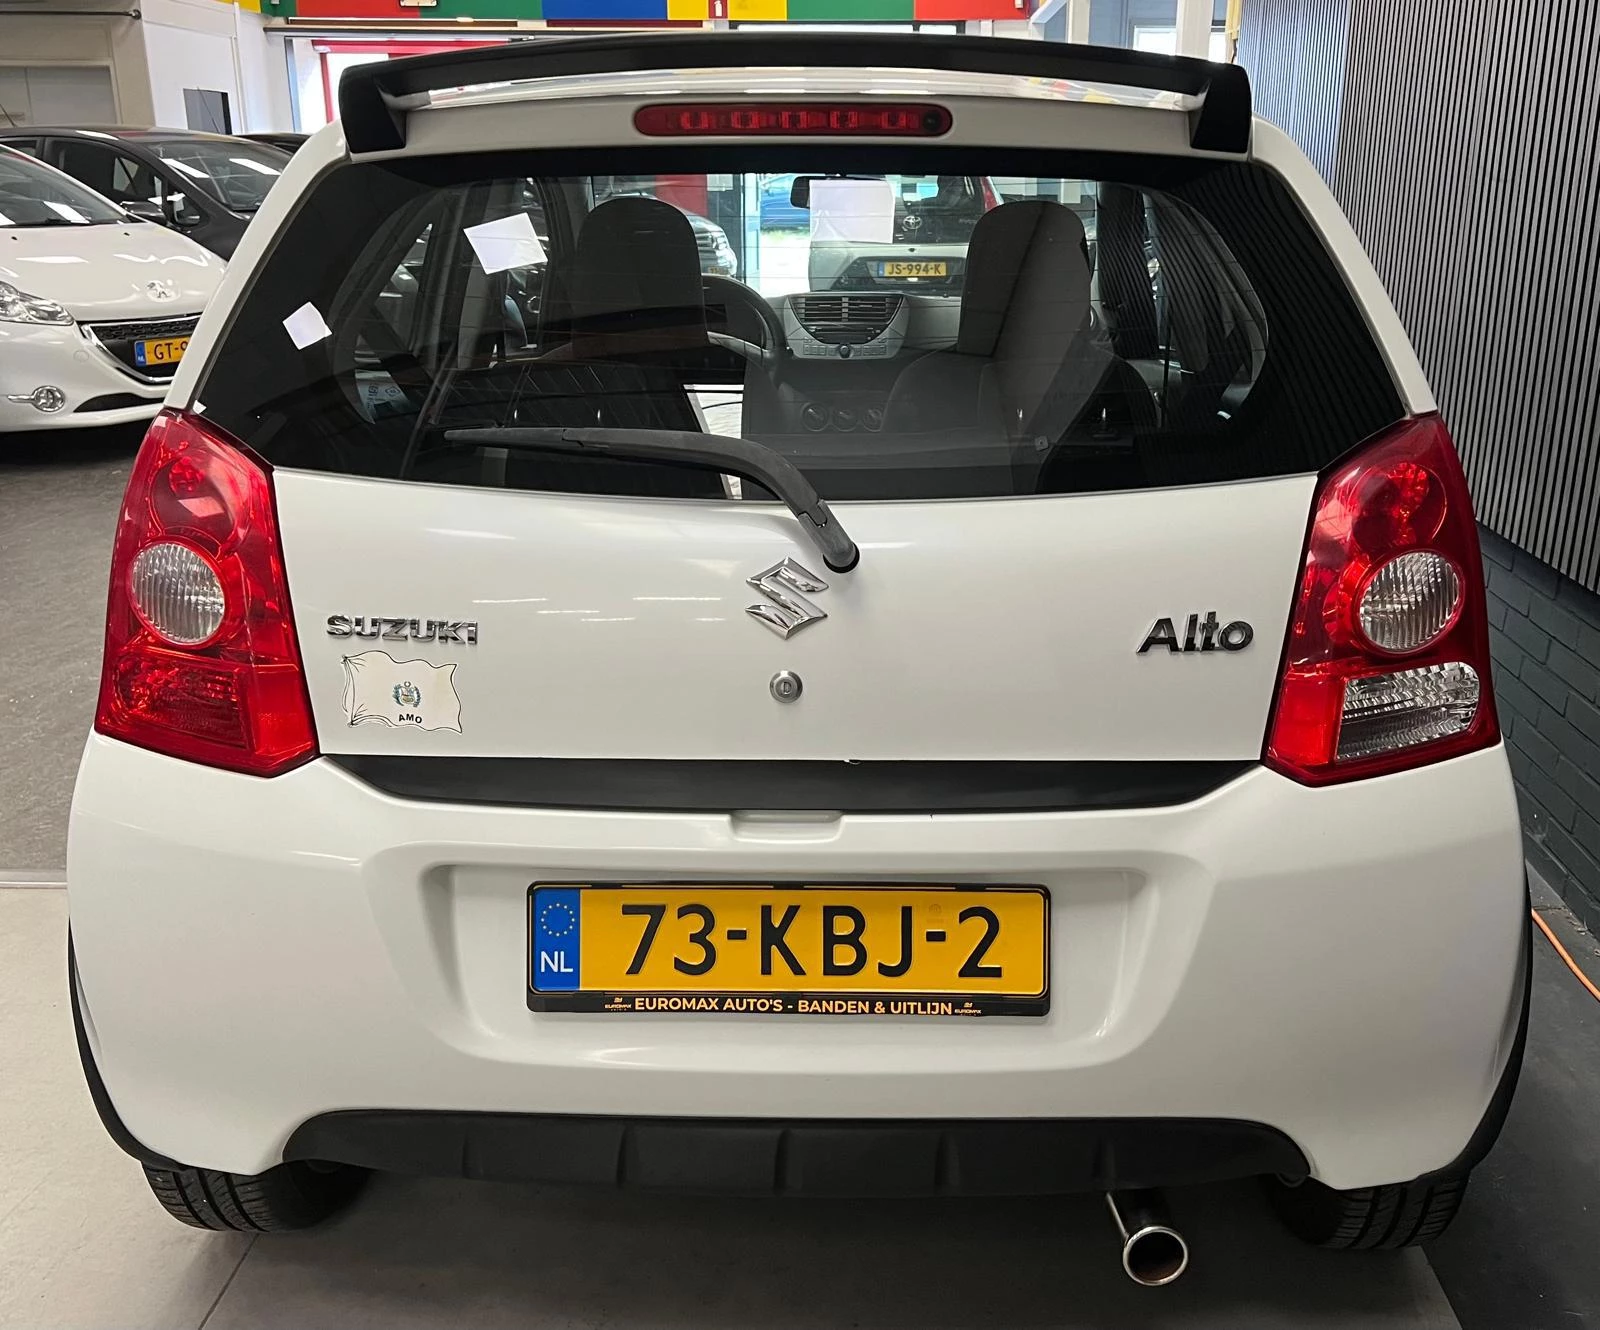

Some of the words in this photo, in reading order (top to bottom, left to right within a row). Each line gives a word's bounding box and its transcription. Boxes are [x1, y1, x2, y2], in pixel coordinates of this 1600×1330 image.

[888, 263, 942, 275] JS-994-K
[326, 614, 479, 645] SUZUKI
[1136, 610, 1254, 653] Alto
[398, 712, 423, 725] AMO
[621, 902, 1003, 979] 73-KBJ-2
[540, 950, 574, 973] NL
[634, 997, 719, 1010] EUROMAX
[722, 998, 783, 1011] AUTO'S
[797, 1000, 869, 1013] BANDEN
[874, 1001, 886, 1013] &
[890, 1002, 952, 1015] UITLIJN
